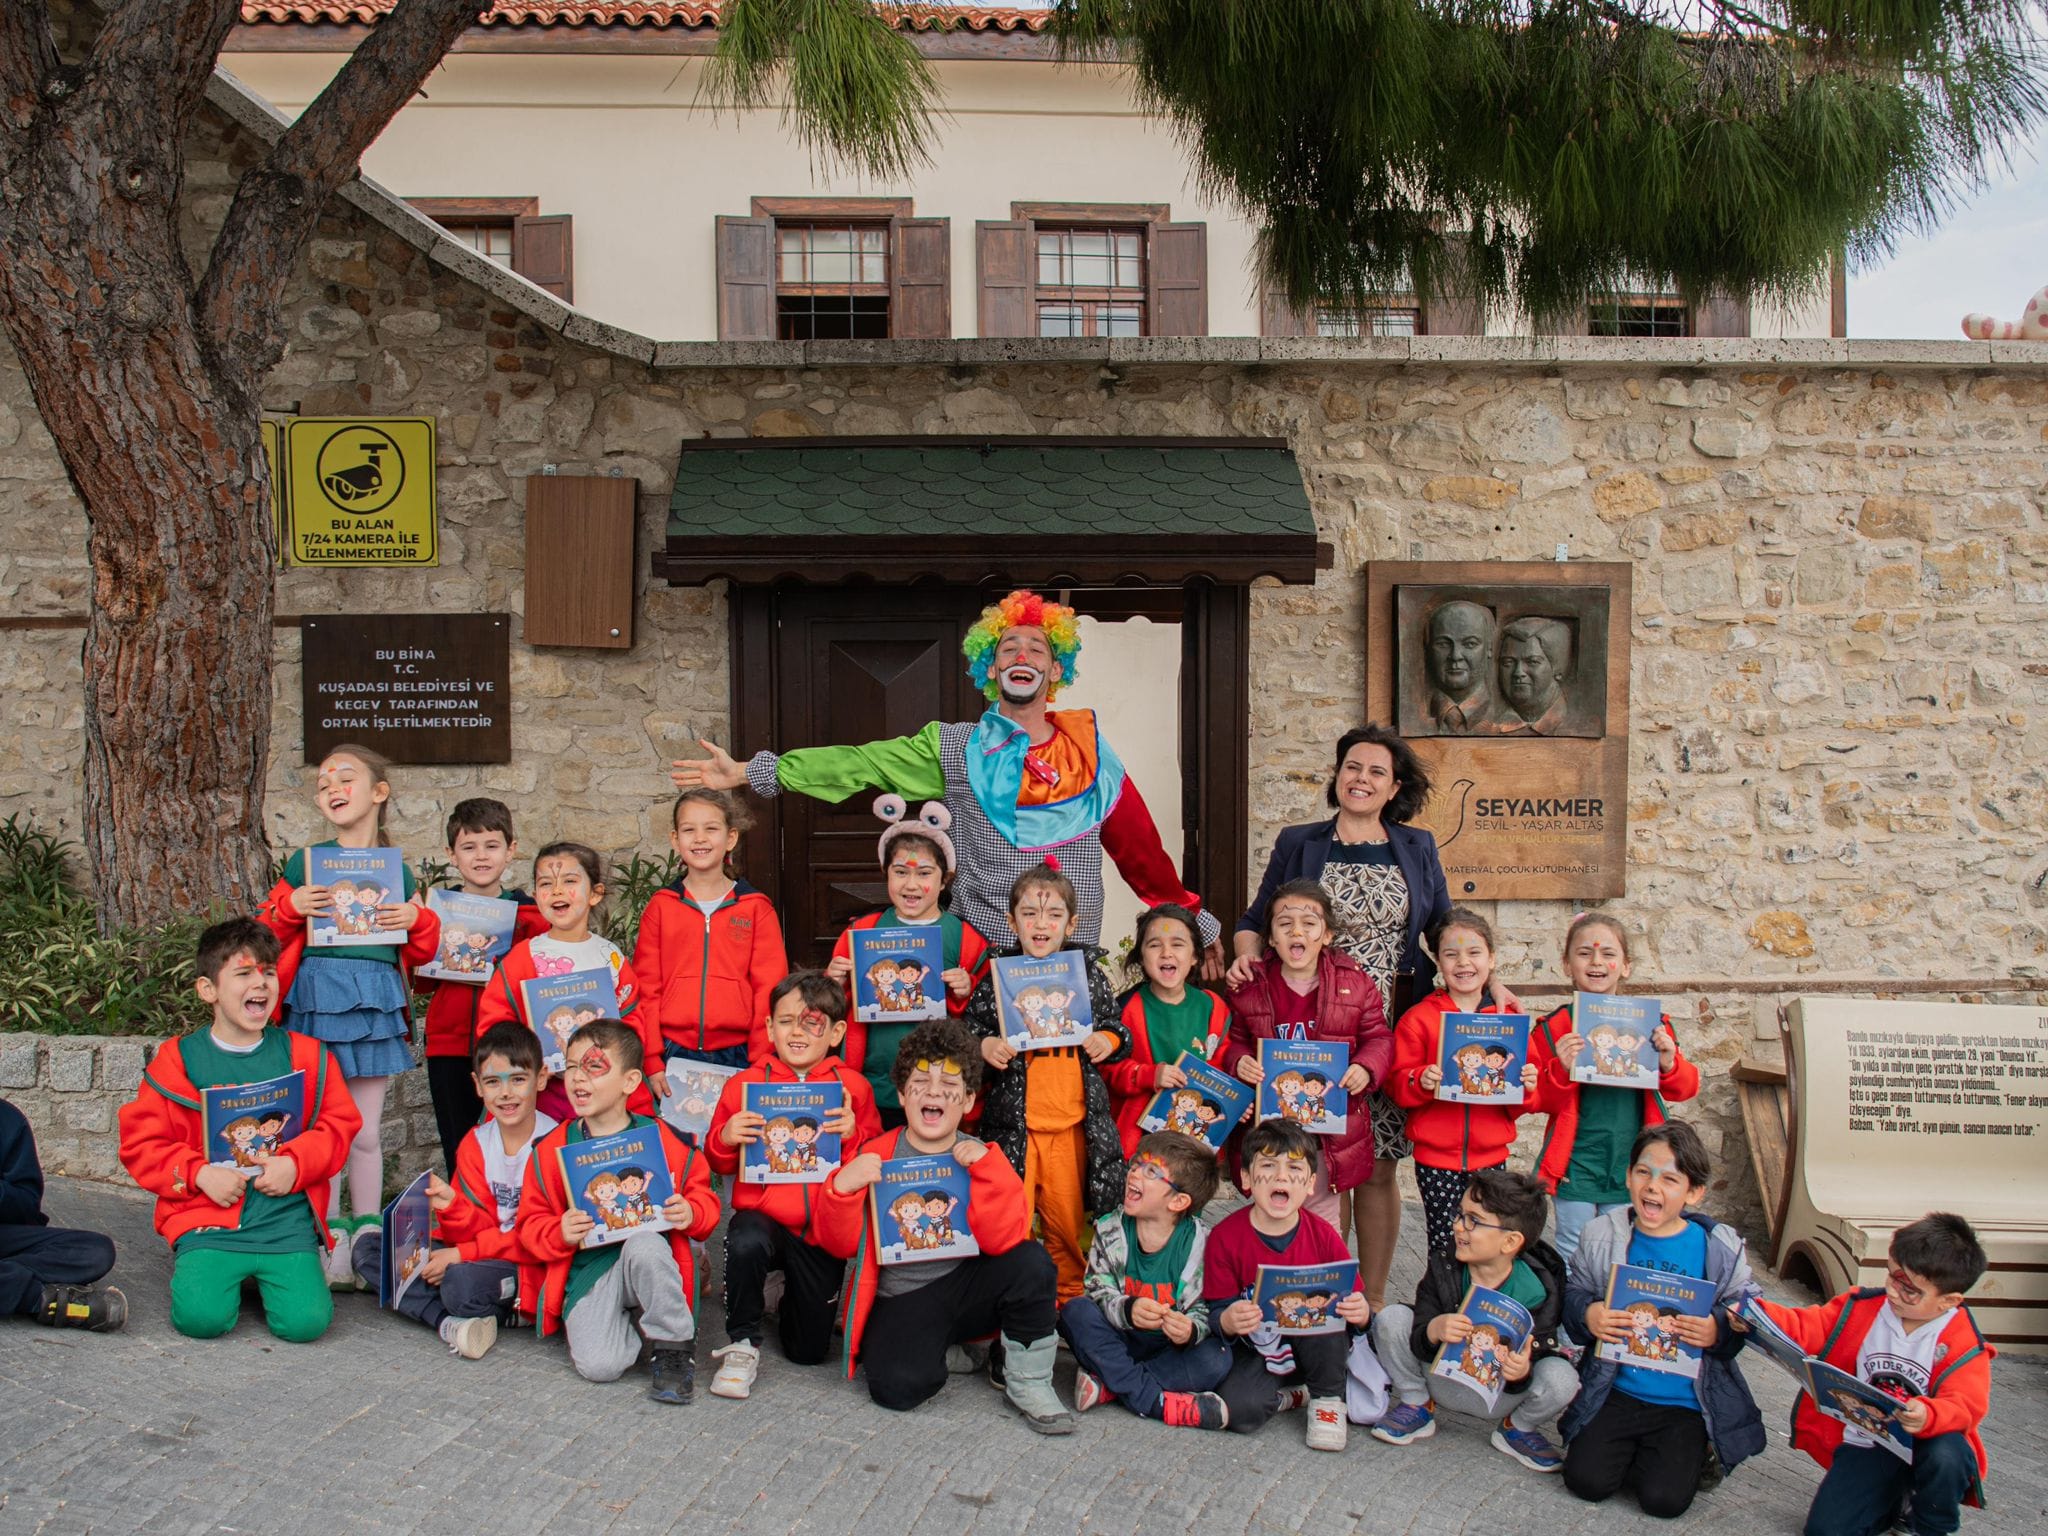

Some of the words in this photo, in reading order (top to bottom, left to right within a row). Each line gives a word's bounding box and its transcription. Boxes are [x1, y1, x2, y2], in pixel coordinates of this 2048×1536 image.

[332, 520, 351, 529] BU
[355, 519, 394, 529] ALAN
[302, 533, 331, 545] 7/24
[335, 534, 395, 544] KAMERA
[399, 531, 420, 544] İLE
[305, 546, 417, 558] İZLENMEKTEDİR
[375, 650, 395, 660] BU
[399, 646, 436, 660] BİNA
[393, 664, 419, 674] T.C.
[318, 682, 389, 695] KUŞADASI
[393, 678, 470, 692] BELEDİYESİ
[475, 682, 495, 692] VE
[335, 700, 381, 710] KEGEV
[389, 699, 479, 710] TARAFINDAN
[322, 718, 368, 728] ORTAK
[373, 713, 492, 731] İŞLETİLMEKTEDİR
[1475, 798, 1604, 817] SEYAKMER
[1474, 819, 1509, 831] SEVİL
[1521, 819, 1562, 832] YAŞAR
[1565, 820, 1604, 832] ALTAŞ
[1445, 866, 1494, 874] MATERYAL
[1496, 866, 1530, 875] ÇOCUK
[1878, 1047, 1909, 1060] aylardan
[1980, 1050, 1995, 1063] yani
[1881, 1063, 1889, 1072] on
[1891, 1061, 1914, 1074] milyon
[1965, 1063, 1978, 1075] her
[2009, 1064, 2023, 1078] diye
[1886, 1075, 1932, 1089] cumhuriyetin
[1934, 1078, 1959, 1089] onuncu
[1865, 1091, 1870, 1101] o
[1871, 1091, 1888, 1103] gece
[1890, 1092, 1912, 1103] annem
[1953, 1093, 1962, 1104] da
